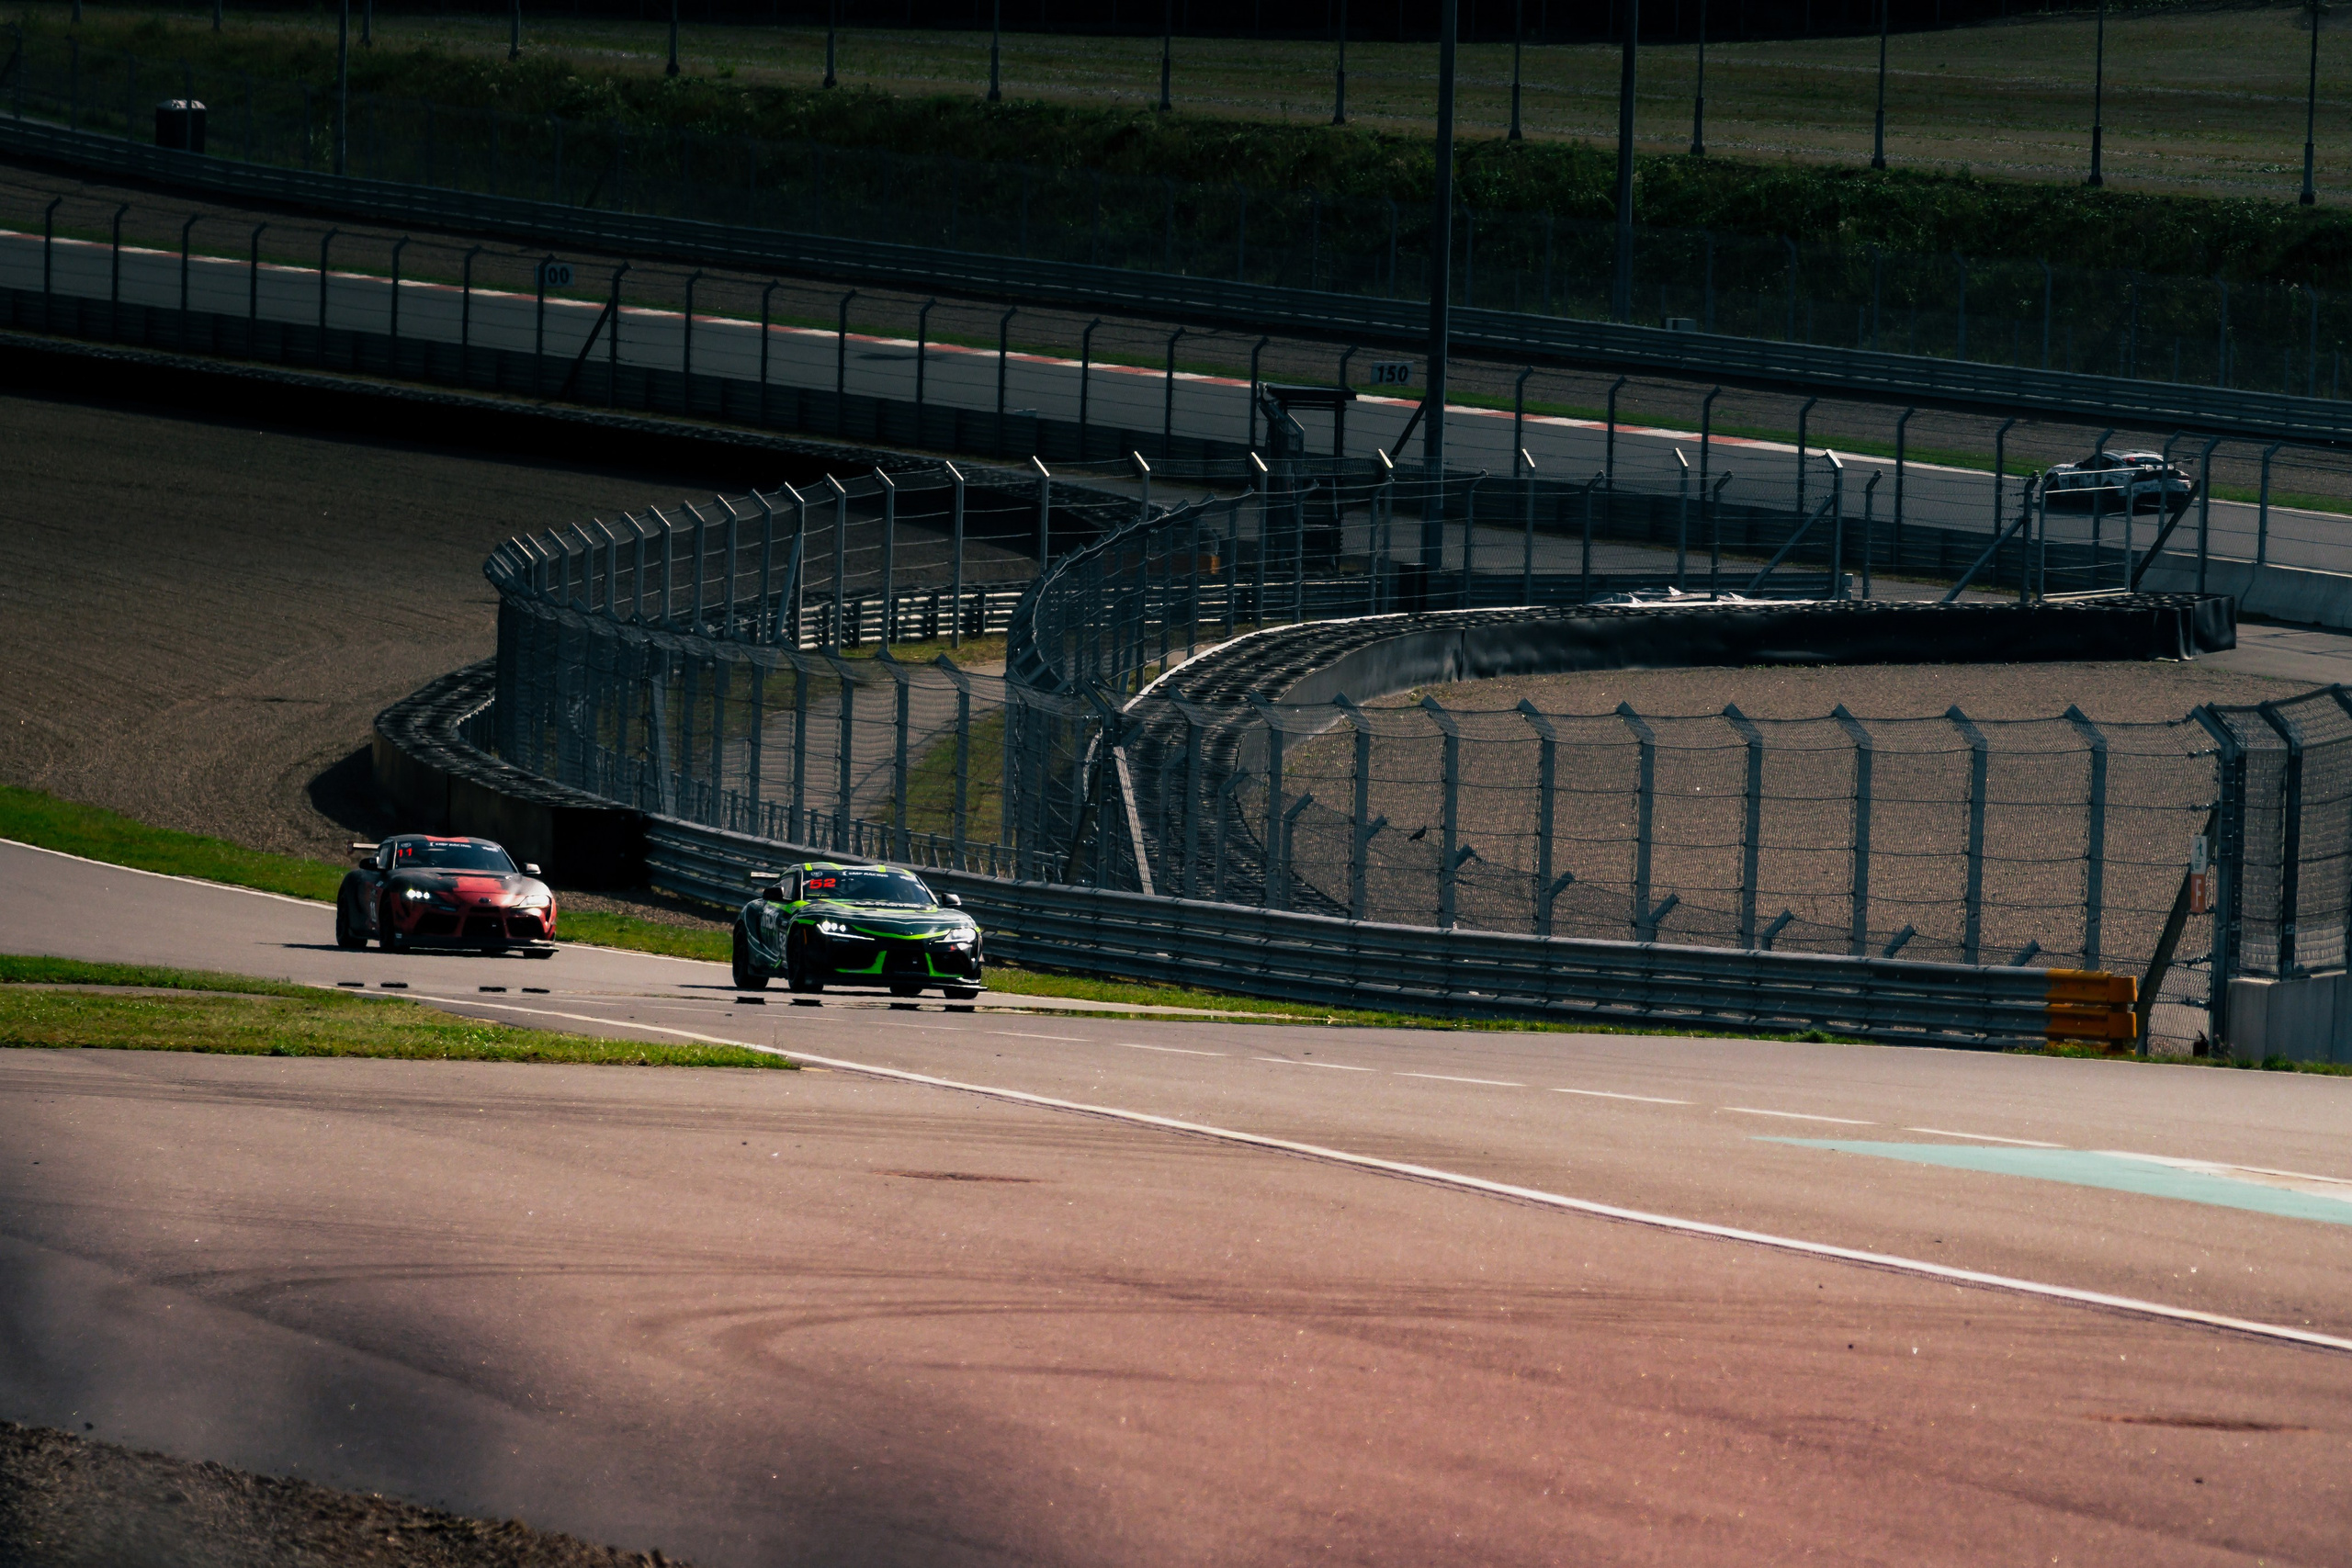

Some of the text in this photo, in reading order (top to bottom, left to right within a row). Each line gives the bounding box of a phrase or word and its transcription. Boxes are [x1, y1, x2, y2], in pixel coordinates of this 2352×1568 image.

[542, 266, 570, 284] 00
[1377, 366, 1408, 382] 150
[397, 847, 413, 856] 11
[809, 878, 836, 889] 52
[2196, 879, 2201, 907] F
